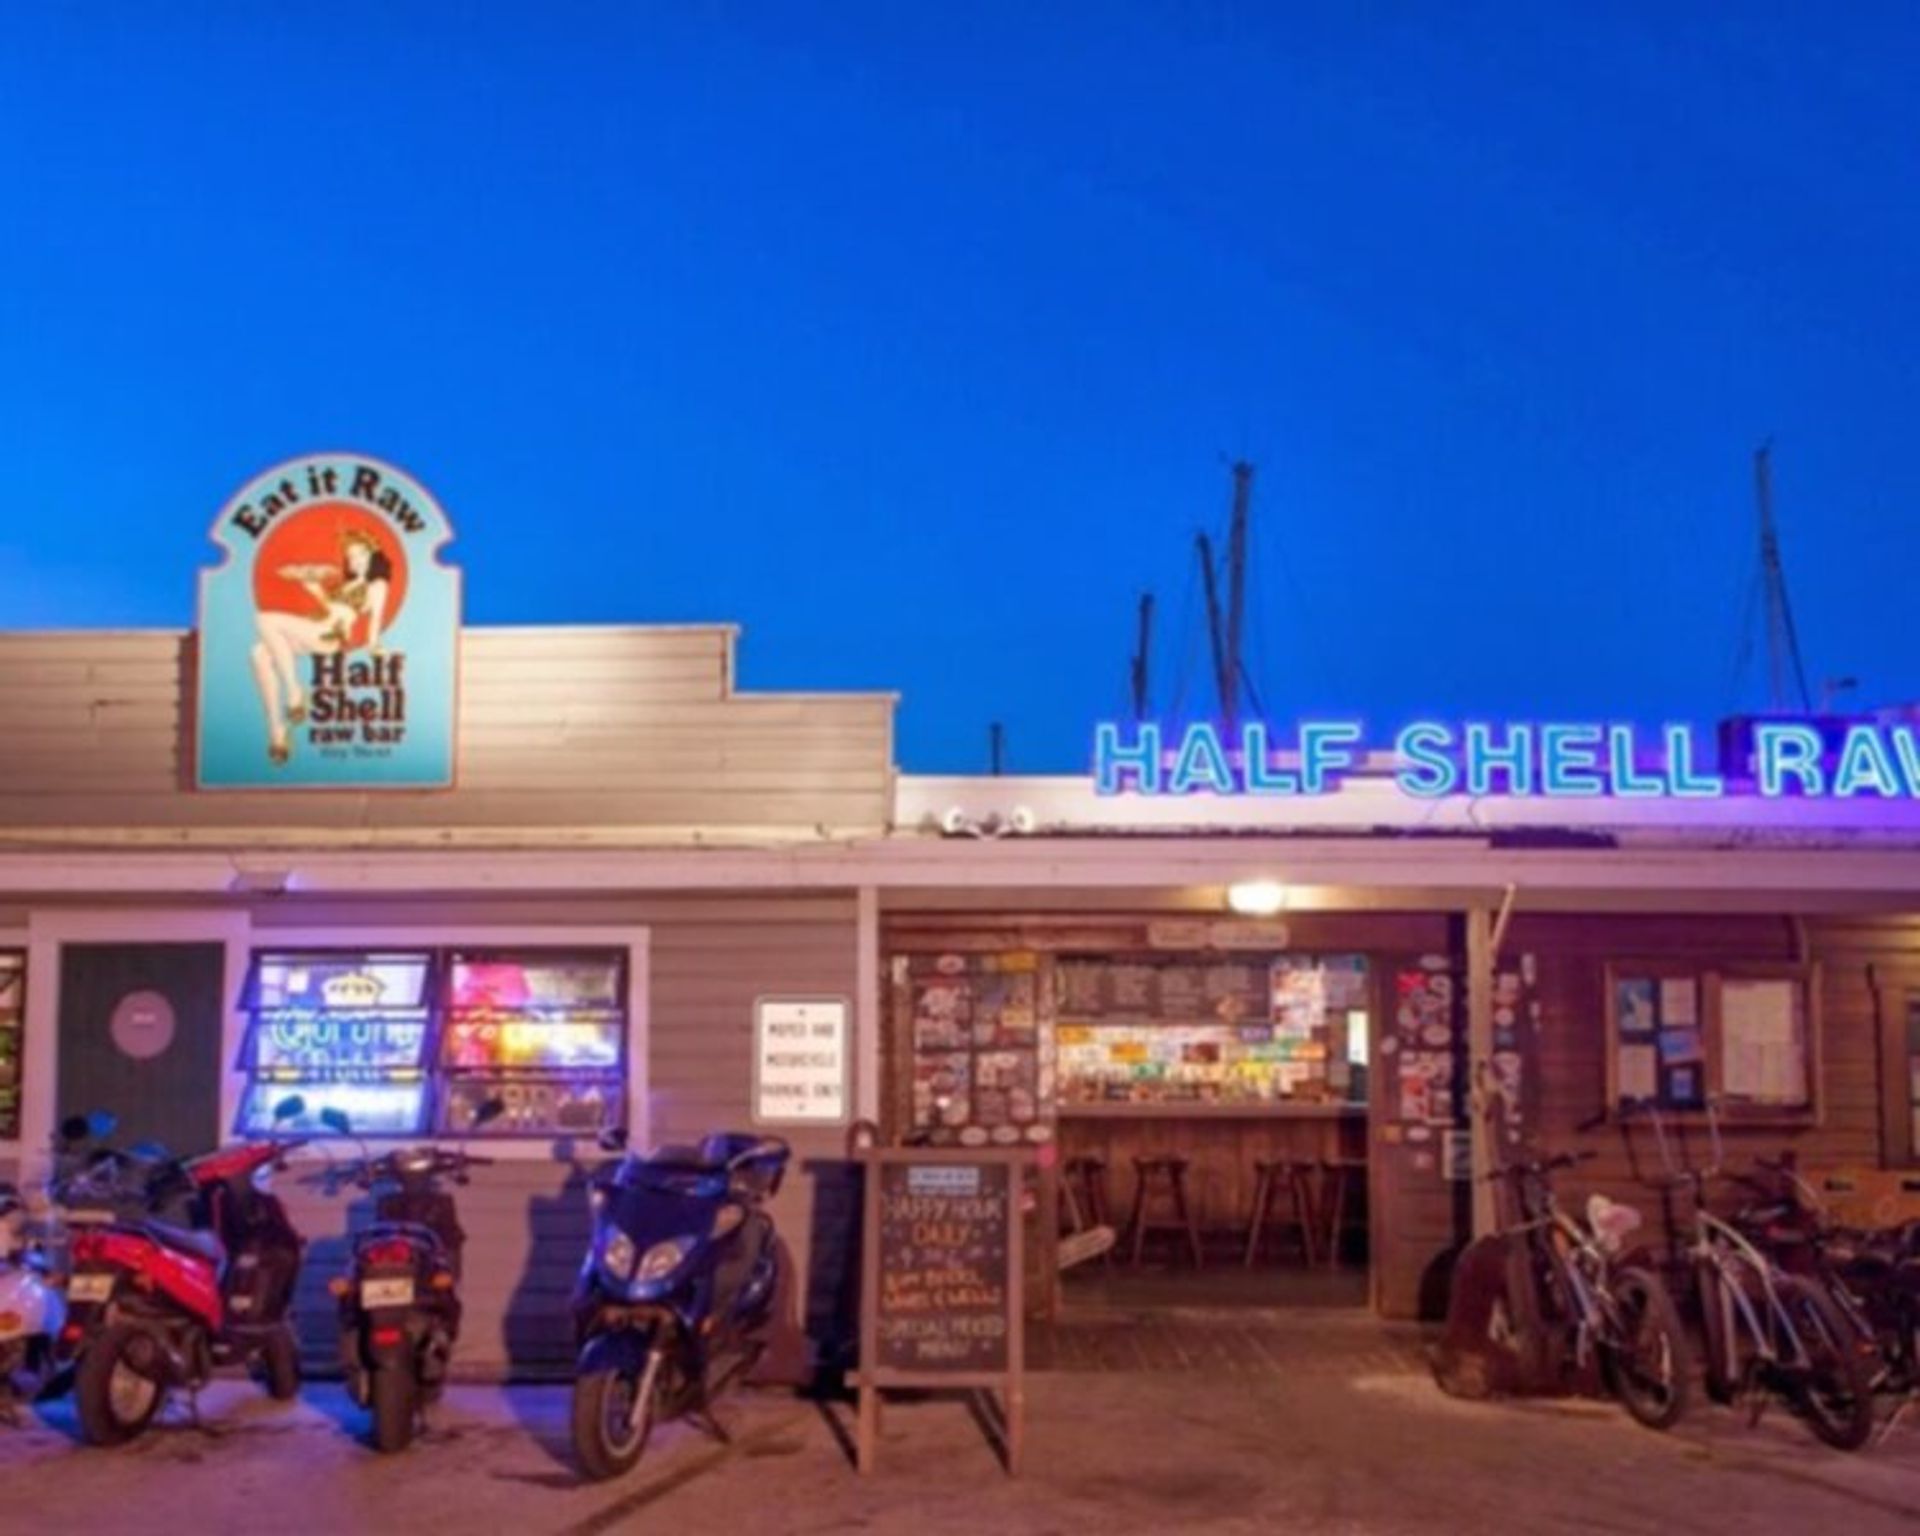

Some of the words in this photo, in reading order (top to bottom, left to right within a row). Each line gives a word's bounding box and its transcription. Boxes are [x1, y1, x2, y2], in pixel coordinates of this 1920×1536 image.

[232, 479, 300, 538] Eat
[307, 465, 337, 496] it
[349, 464, 426, 534] Raw
[310, 652, 406, 687] Half
[309, 688, 406, 723] Shell
[308, 726, 355, 745] raw
[362, 725, 406, 744] bar
[1094, 722, 1362, 796] HALF
[1395, 722, 1722, 799] SHELL
